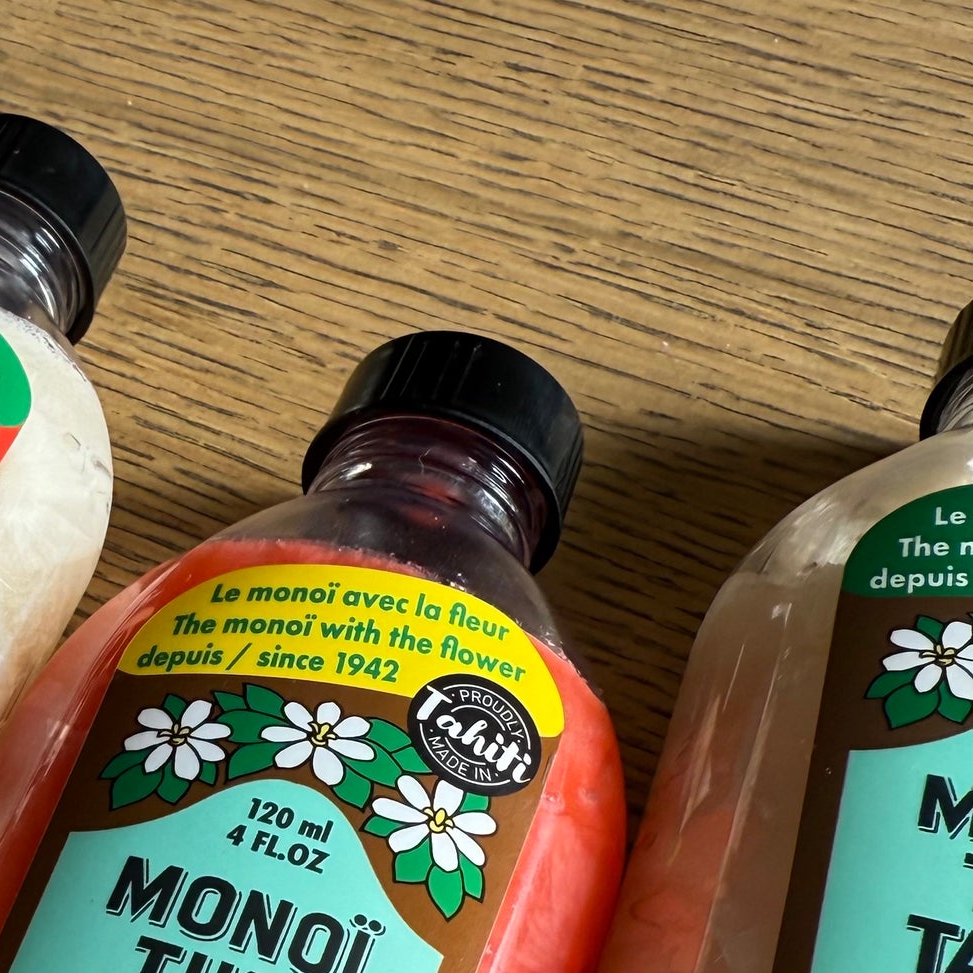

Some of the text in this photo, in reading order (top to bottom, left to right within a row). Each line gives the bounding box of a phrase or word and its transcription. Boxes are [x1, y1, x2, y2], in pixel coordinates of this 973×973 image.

[935, 506, 967, 526] Le
[899, 535, 950, 558] The
[869, 565, 969, 594] depuis
[210, 581, 511, 642] Le monoï avec la fleur
[136, 641, 225, 672] depuis
[256, 644, 325, 673] since
[335, 651, 401, 684] 1942
[172, 612, 528, 683] The monoï with the flower
[416, 684, 532, 784] Tahiti
[459, 689, 525, 740] PROUDLY
[428, 736, 492, 782] MADE IN
[246, 797, 335, 845] 120 ml
[226, 823, 331, 875] 4 FL.OZ
